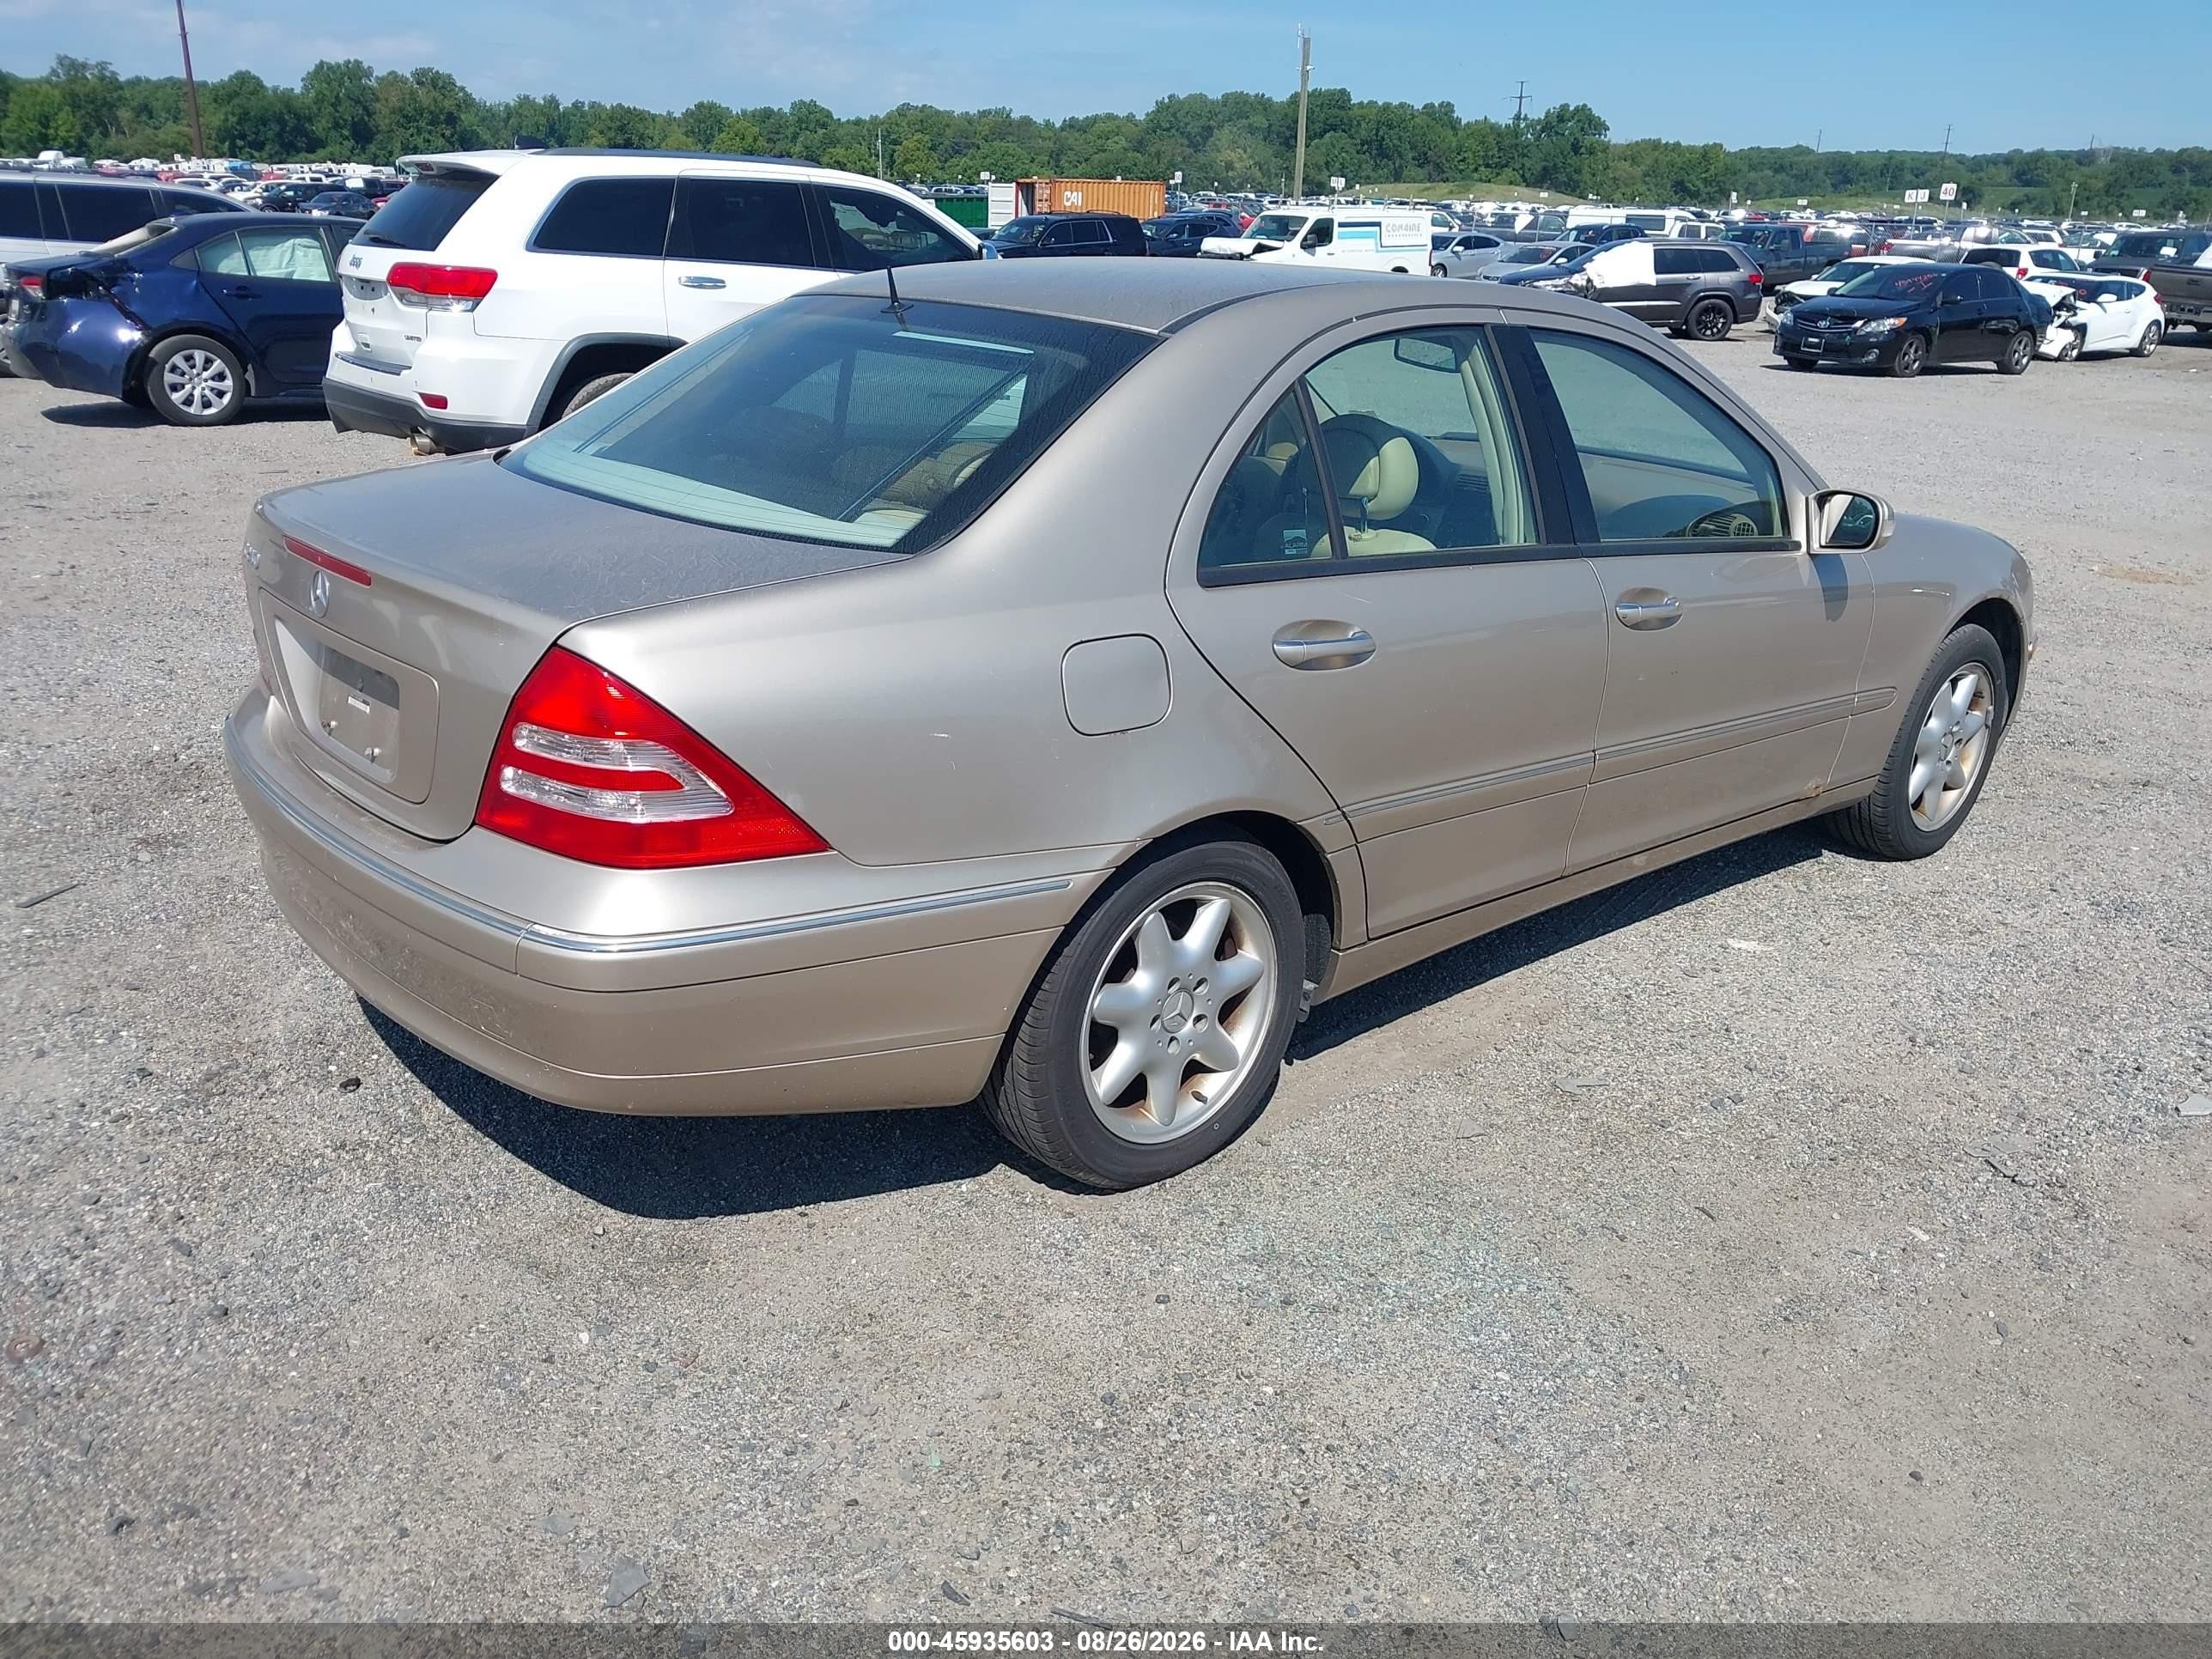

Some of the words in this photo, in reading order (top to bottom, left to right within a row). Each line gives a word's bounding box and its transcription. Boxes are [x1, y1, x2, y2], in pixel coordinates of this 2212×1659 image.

[1907, 191, 1914, 200] K
[1942, 187, 1954, 197] 40
[1063, 191, 1082, 207] CAI
